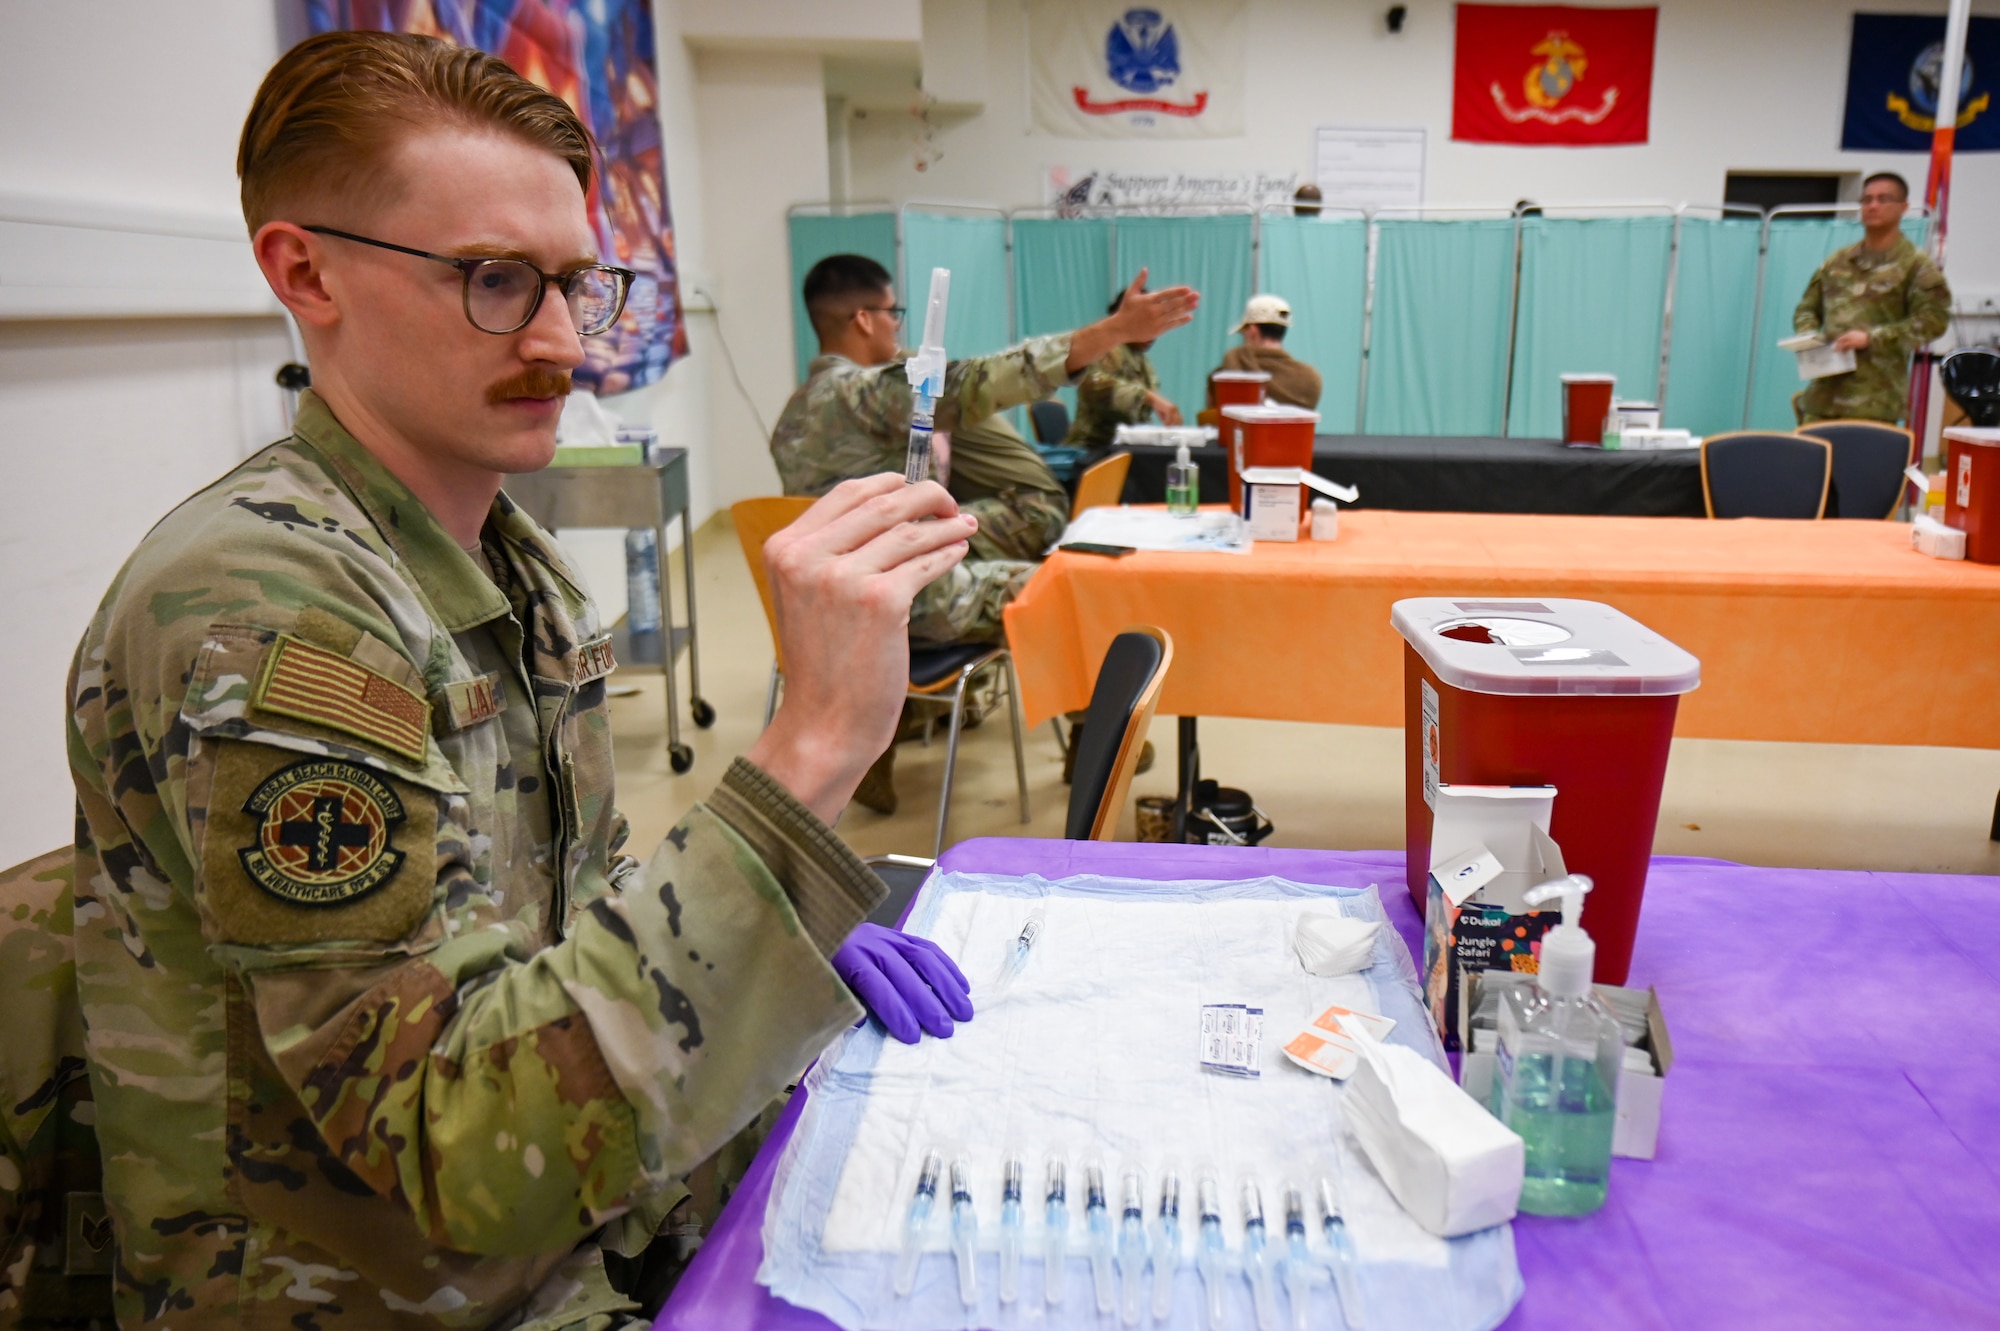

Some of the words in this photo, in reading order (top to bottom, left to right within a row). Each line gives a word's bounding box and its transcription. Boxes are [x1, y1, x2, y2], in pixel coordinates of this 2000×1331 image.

[1107, 172, 1169, 194] Support
[1175, 173, 1250, 194] America's
[337, 764, 377, 792] GLOBAL
[375, 788, 402, 819] CARE
[265, 874, 347, 900] HEALTHCARE
[350, 875, 376, 895] OPS
[1469, 916, 1502, 927] Dukal
[1457, 936, 1497, 949] Jungle
[1457, 946, 1491, 958] Safari
